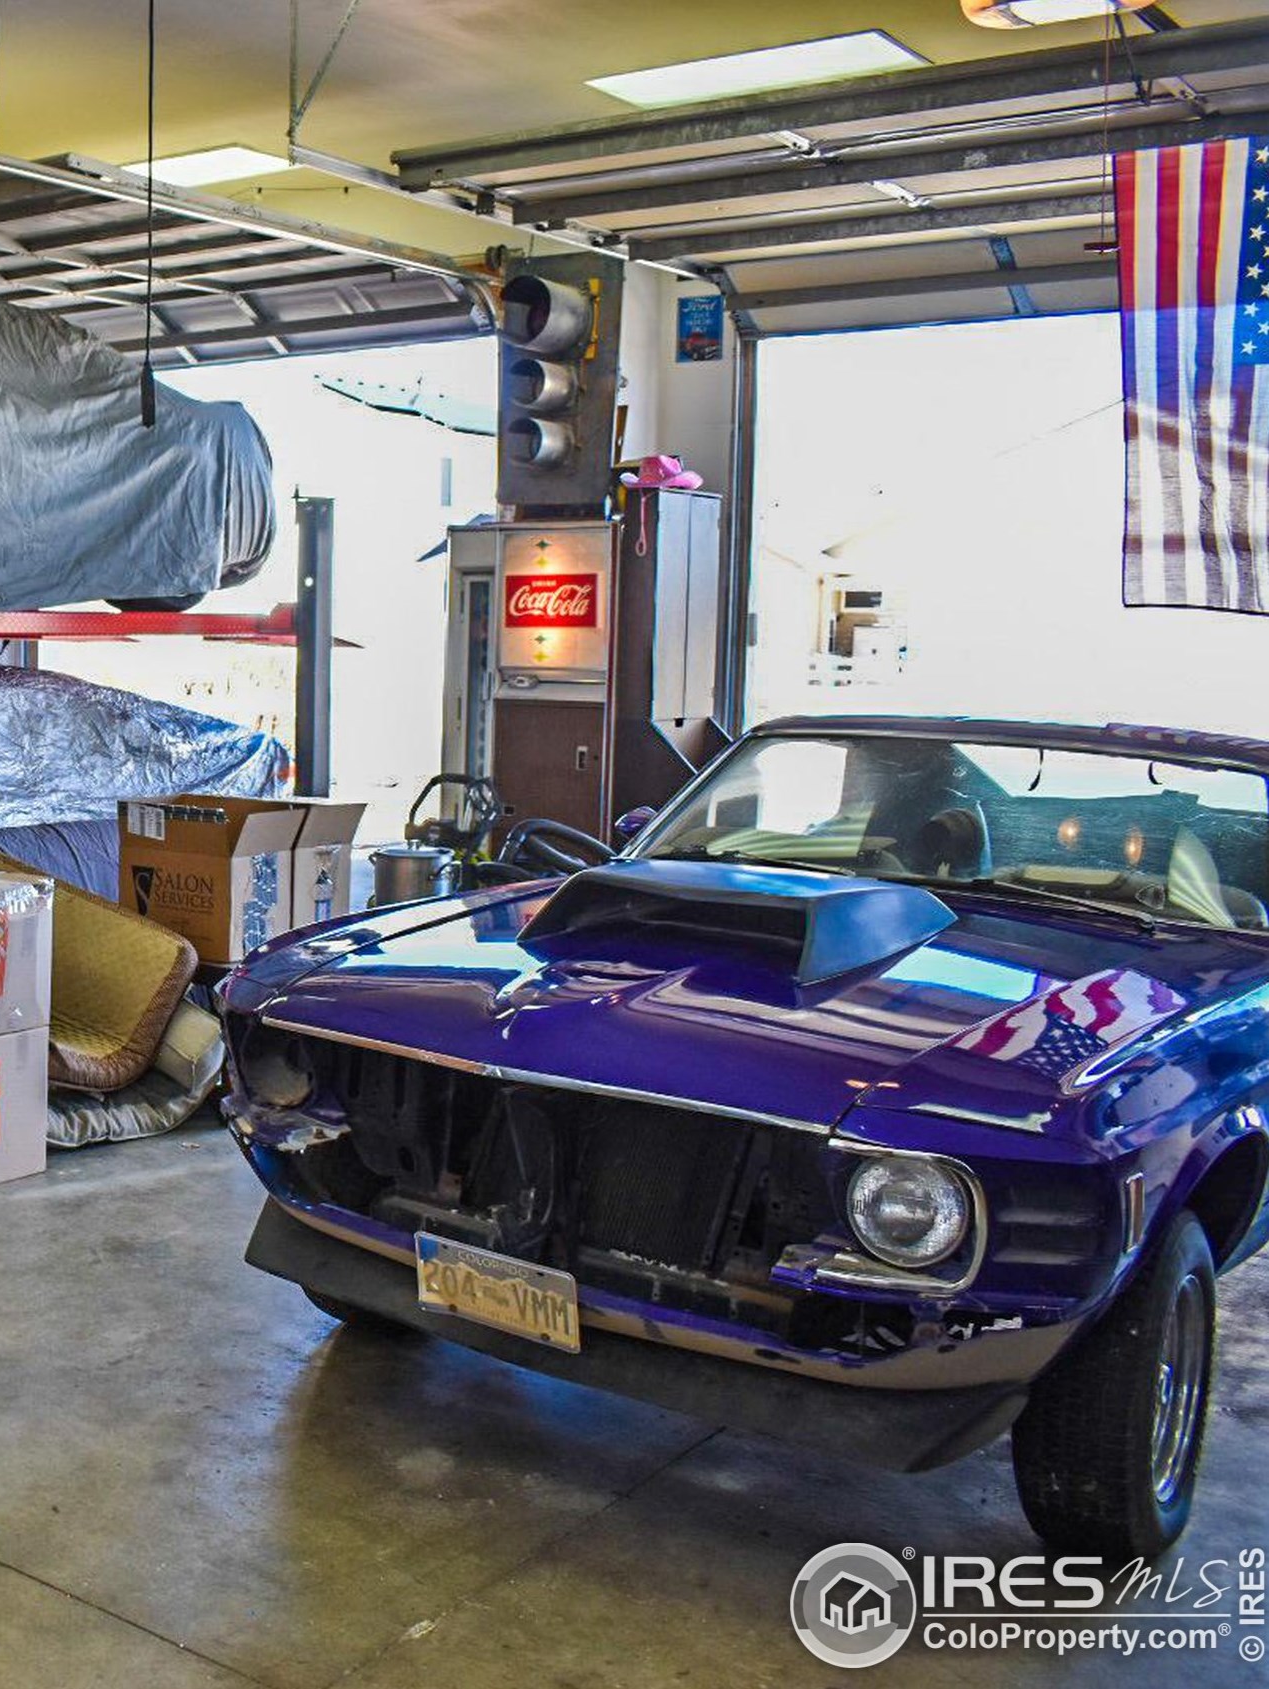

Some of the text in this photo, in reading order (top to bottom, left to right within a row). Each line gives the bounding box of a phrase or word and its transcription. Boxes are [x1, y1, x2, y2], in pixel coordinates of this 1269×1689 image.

[509, 584, 592, 617] Coca-Cola
[154, 867, 214, 893] SALON
[154, 890, 214, 909] SERVICES
[457, 1250, 529, 1279] COLORADO
[512, 1282, 571, 1336] VMM
